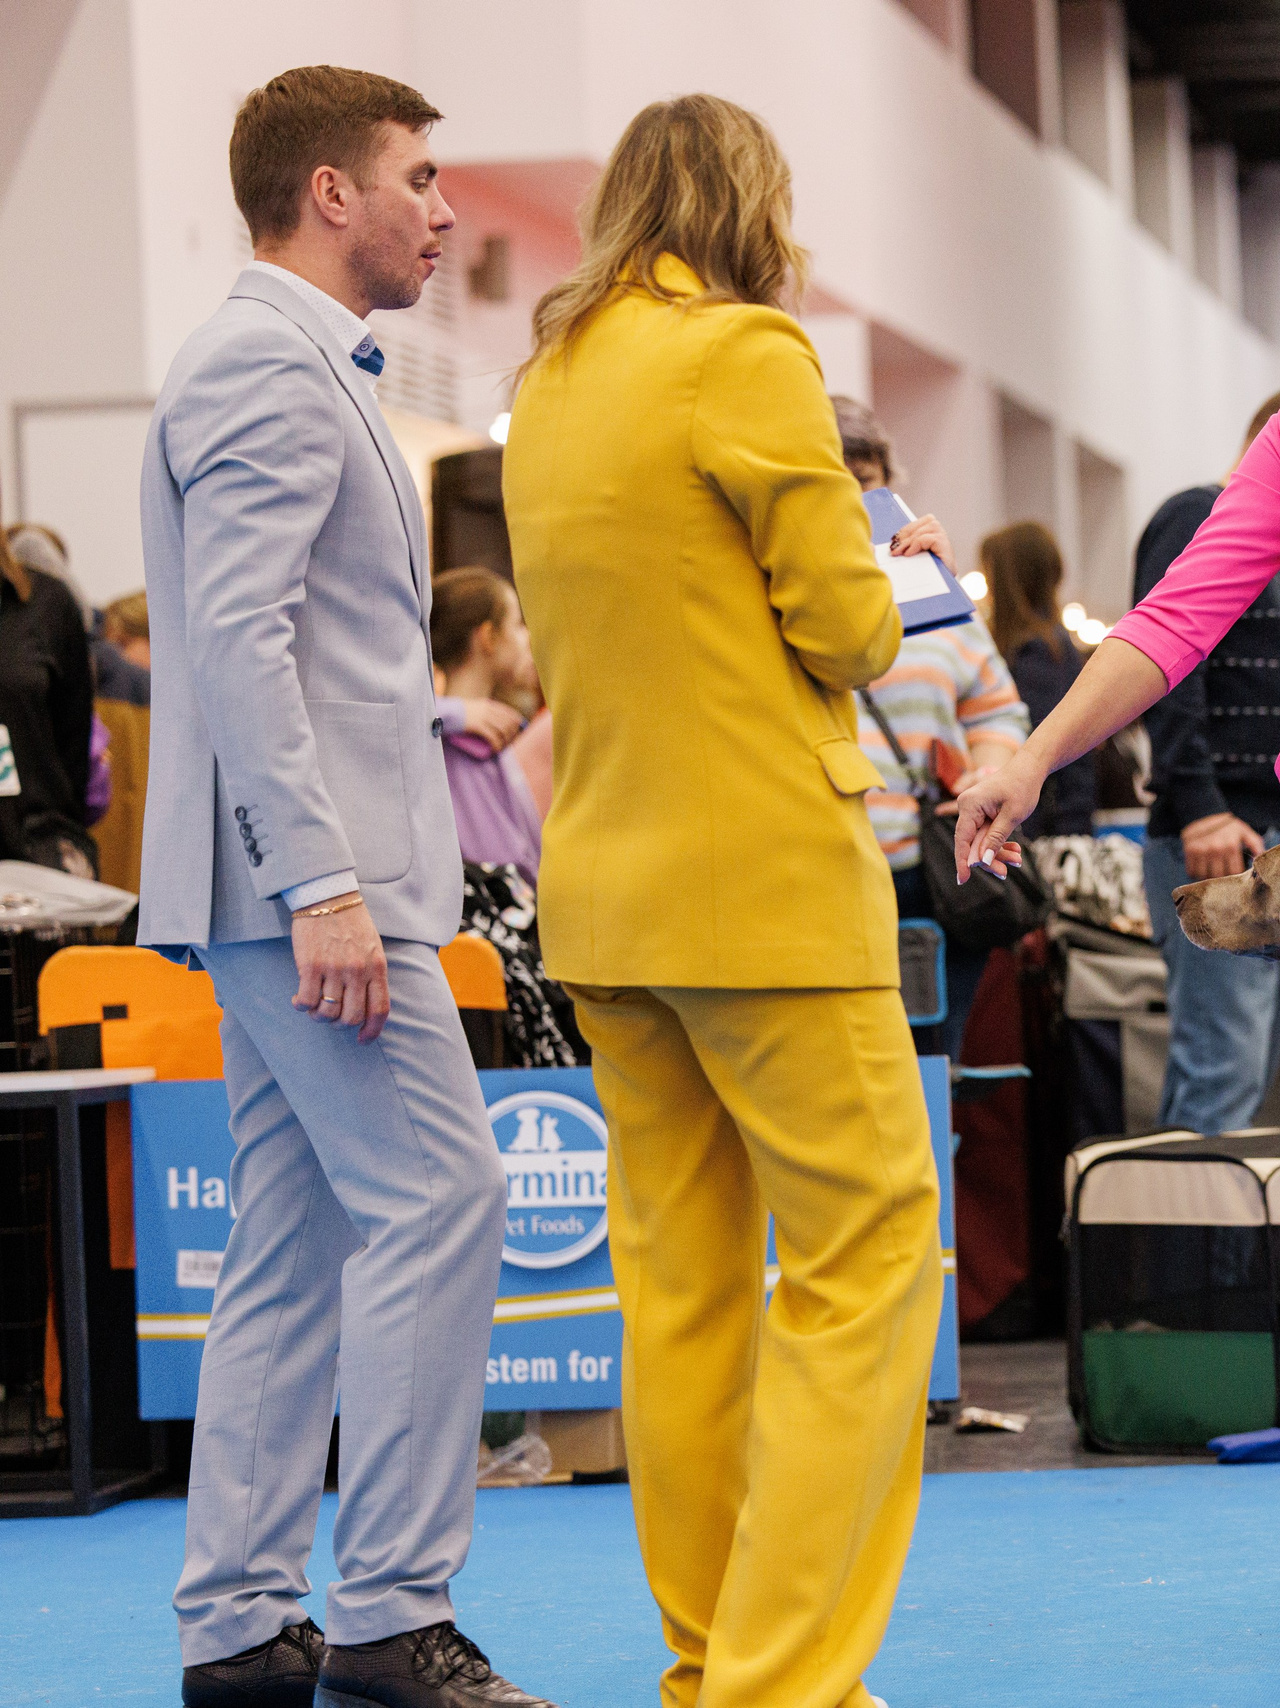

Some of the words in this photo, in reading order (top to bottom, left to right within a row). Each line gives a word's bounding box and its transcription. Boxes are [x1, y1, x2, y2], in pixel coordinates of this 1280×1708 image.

[168, 1166, 237, 1219] Ha
[507, 1159, 607, 1198] rmin
[506, 1217, 526, 1236] et
[531, 1214, 585, 1236] Foods
[486, 1353, 558, 1384] stem
[568, 1349, 613, 1382] for
